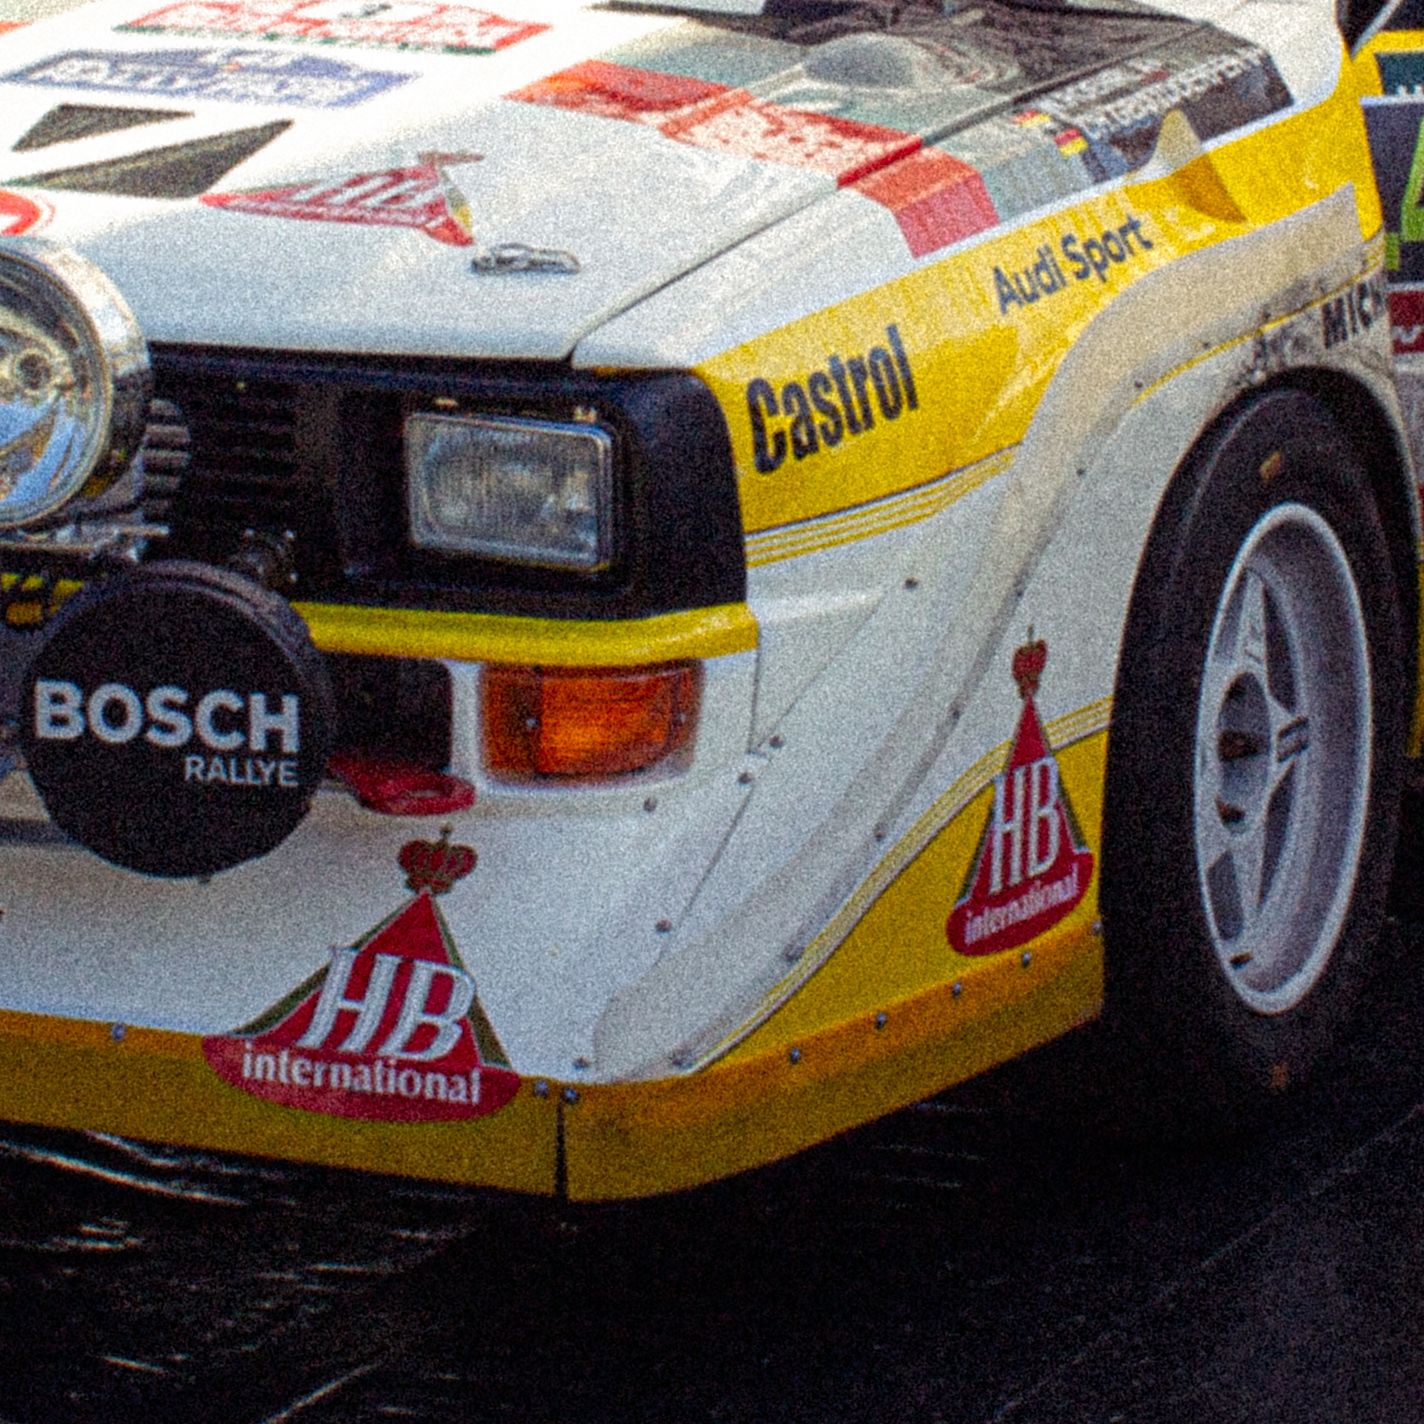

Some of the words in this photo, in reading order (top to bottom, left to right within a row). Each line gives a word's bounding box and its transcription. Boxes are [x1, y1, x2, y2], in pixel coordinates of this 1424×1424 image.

[992, 242, 1064, 315] Audi
[1060, 214, 1154, 285] Sport
[745, 323, 919, 475] Castrol
[33, 678, 300, 755] BOSCH
[183, 754, 300, 788] RALLYE
[988, 762, 1063, 896] HB
[963, 863, 1083, 945] international
[297, 944, 477, 1063] HB
[242, 1042, 482, 1106] international
